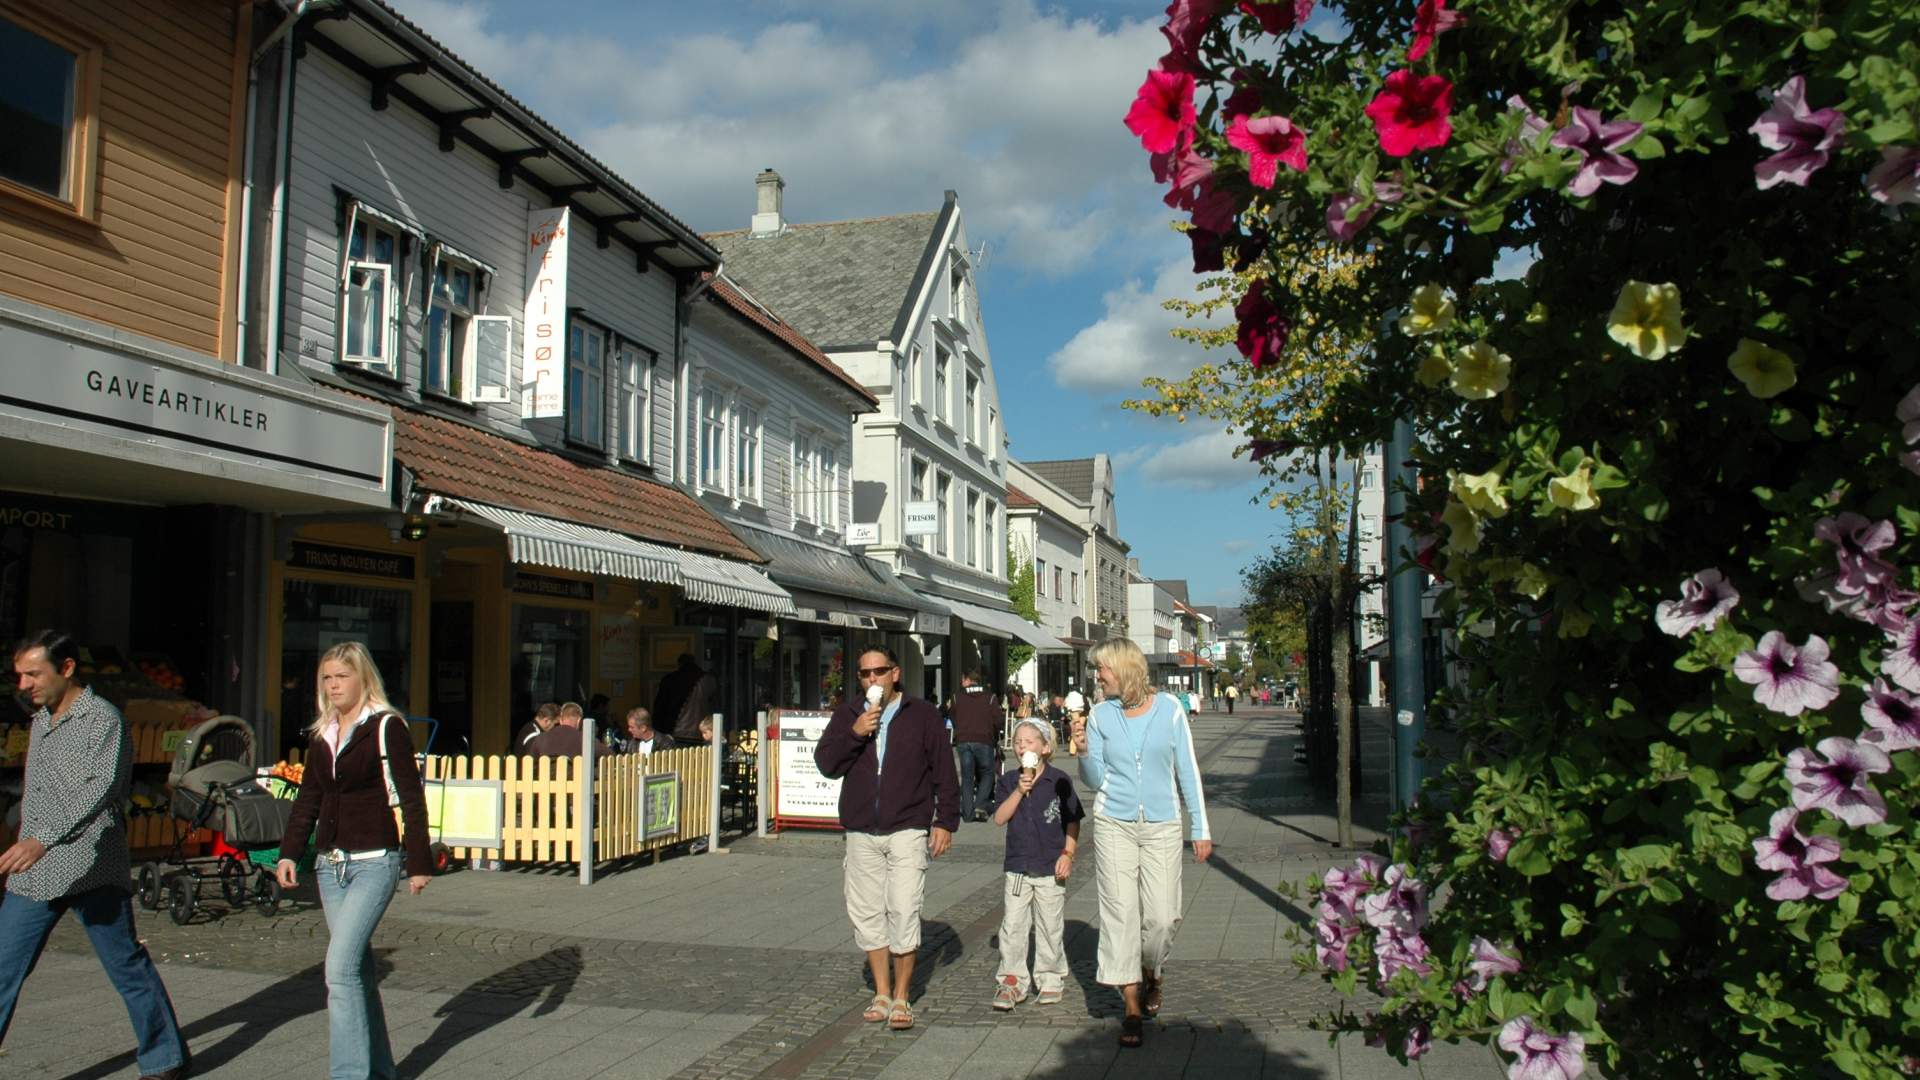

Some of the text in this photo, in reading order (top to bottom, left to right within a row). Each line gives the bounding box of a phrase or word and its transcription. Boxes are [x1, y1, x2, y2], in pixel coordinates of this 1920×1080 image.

[530, 226, 566, 254] Kim's
[535, 249, 553, 385] frisør
[87, 370, 268, 431] GAVEARTIKLER
